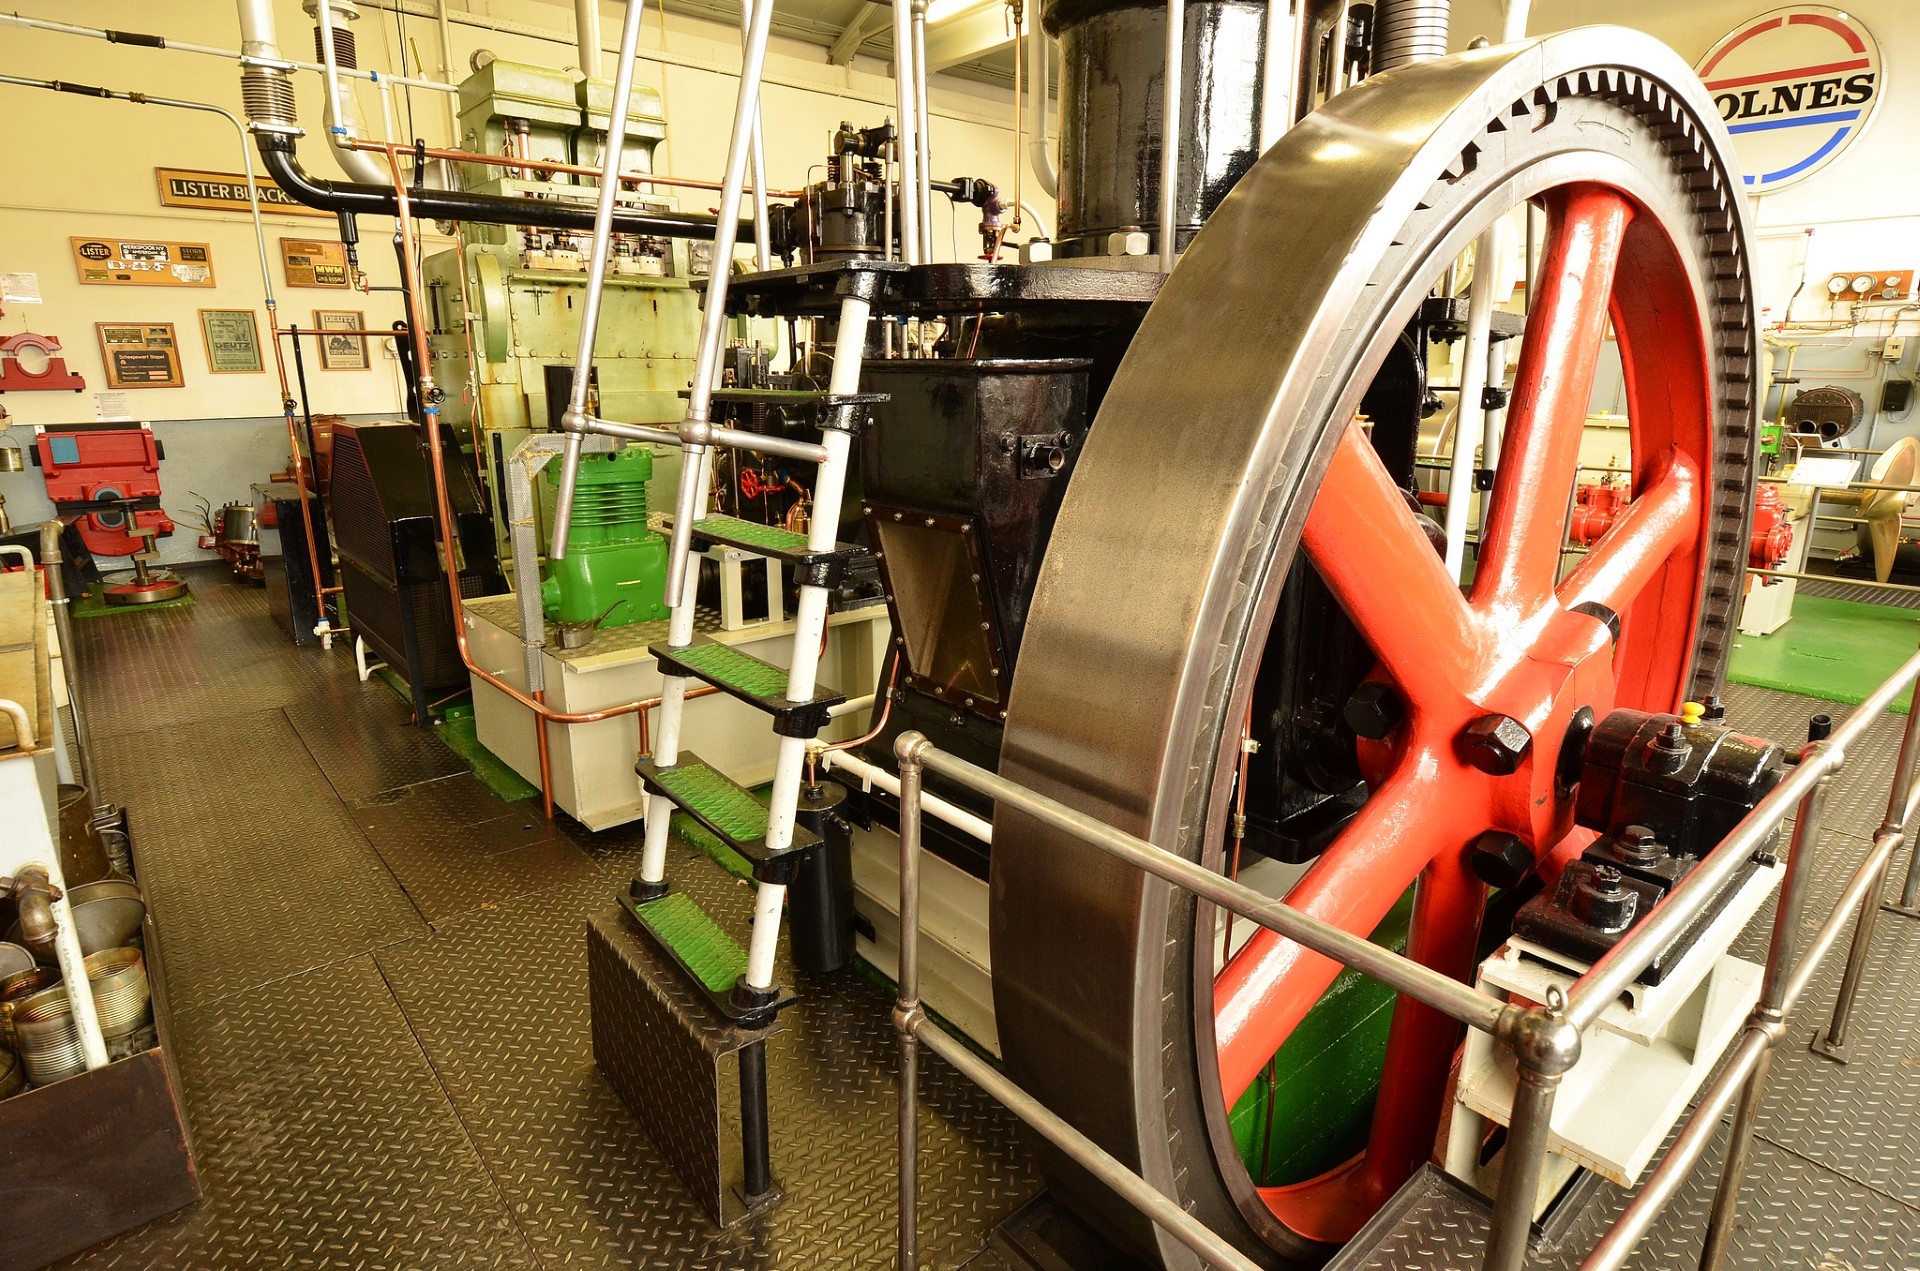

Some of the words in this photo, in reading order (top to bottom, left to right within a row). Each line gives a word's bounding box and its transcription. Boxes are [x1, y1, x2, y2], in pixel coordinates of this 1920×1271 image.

[171, 180, 230, 198] LISTER
[80, 247, 110, 256] LISTER
[315, 265, 344, 273] MWM
[215, 341, 252, 349] DEUTZ
